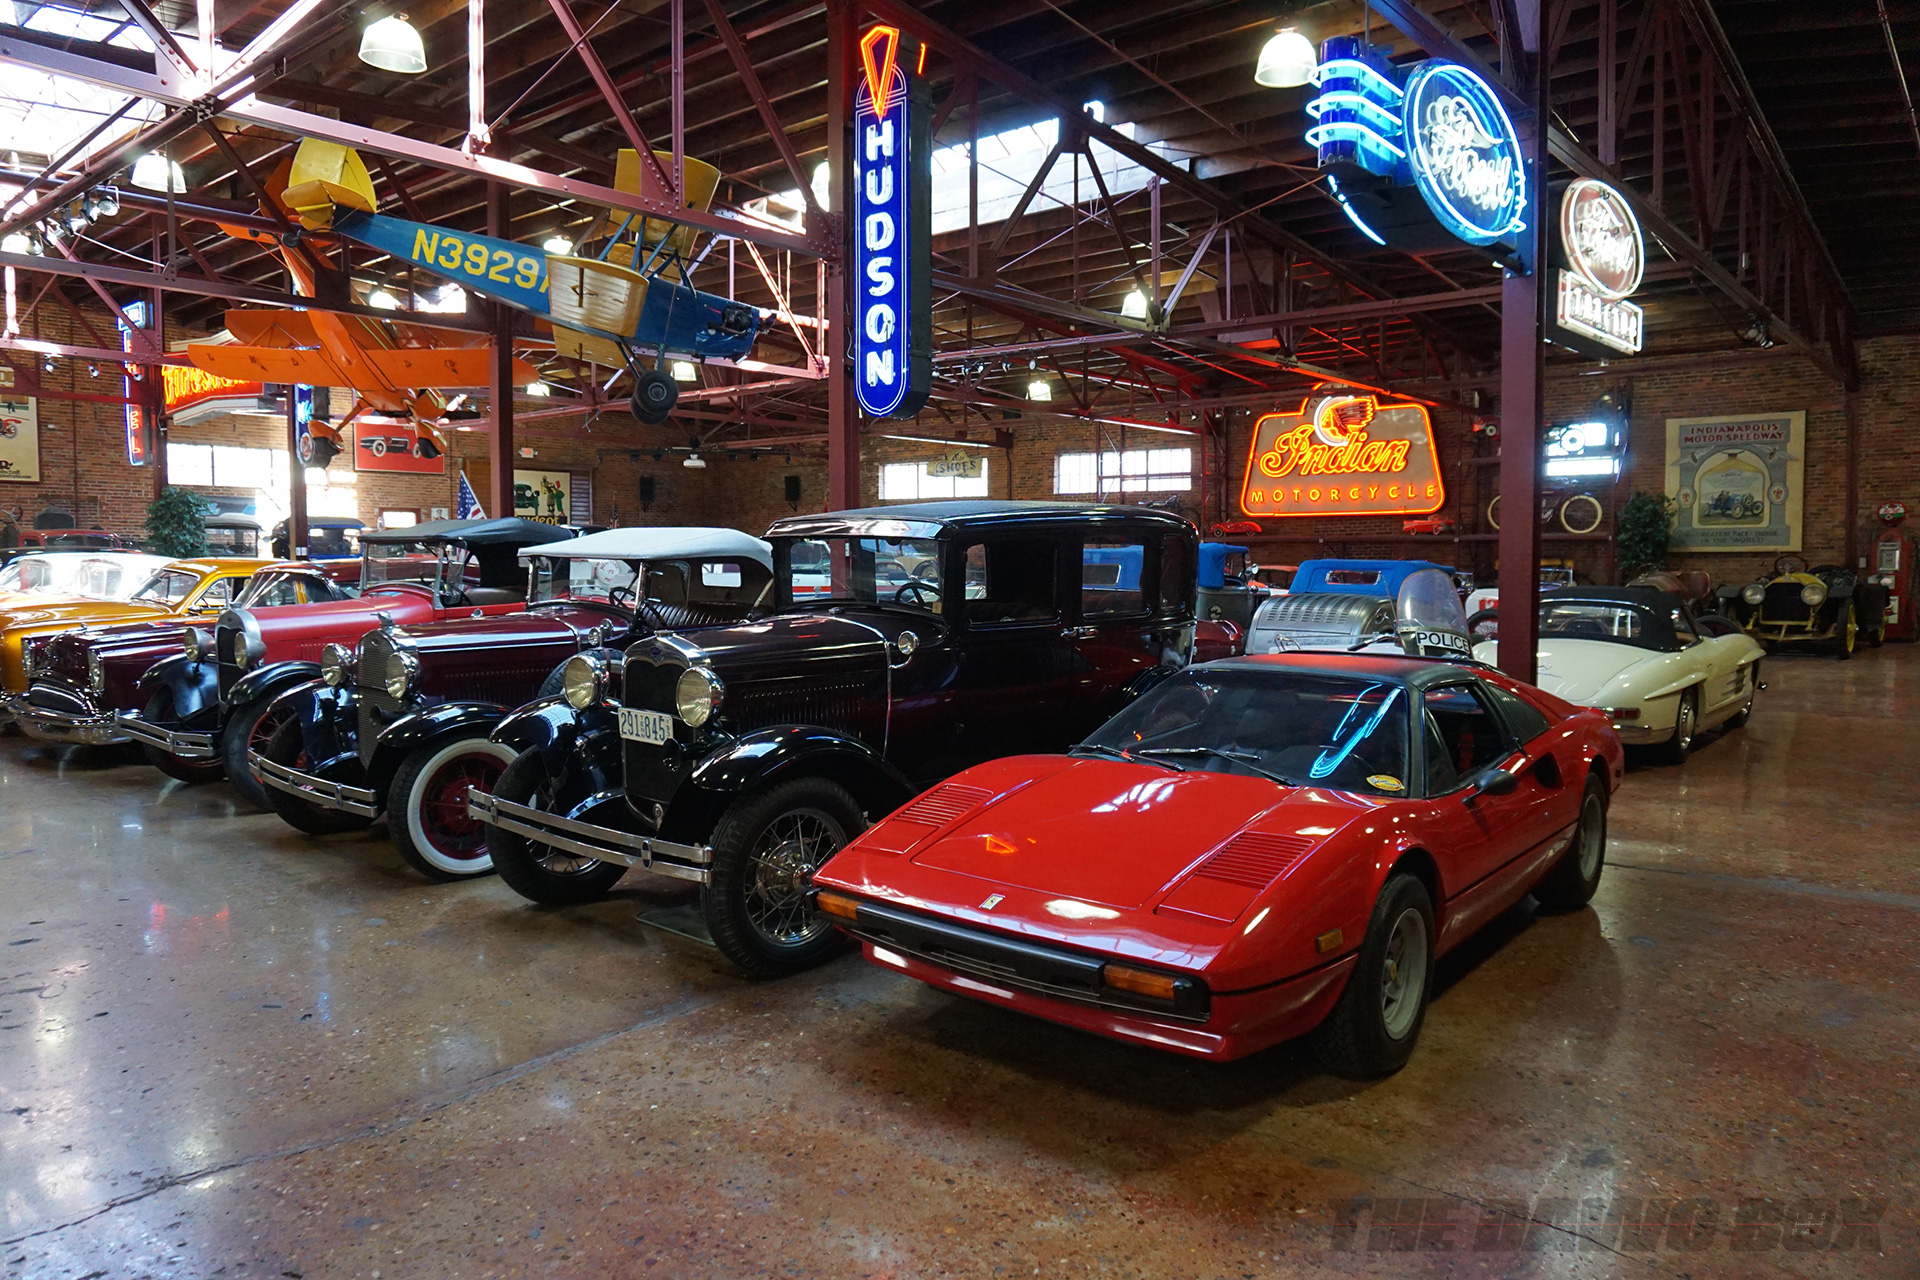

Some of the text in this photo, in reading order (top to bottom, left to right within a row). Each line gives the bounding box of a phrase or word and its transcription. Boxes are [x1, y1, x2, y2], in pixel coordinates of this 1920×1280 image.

[411, 228, 549, 294] N3929
[865, 119, 895, 387] HUDSON
[1684, 432, 1784, 443] MOTOR SPEEDWAY
[1691, 423, 1778, 434] INDIANAPOLIS
[1260, 424, 1410, 478] Indian
[1251, 484, 1436, 503] MOTORCYCLE
[1417, 632, 1470, 653] POLICE
[621, 712, 665, 741] 291 845
